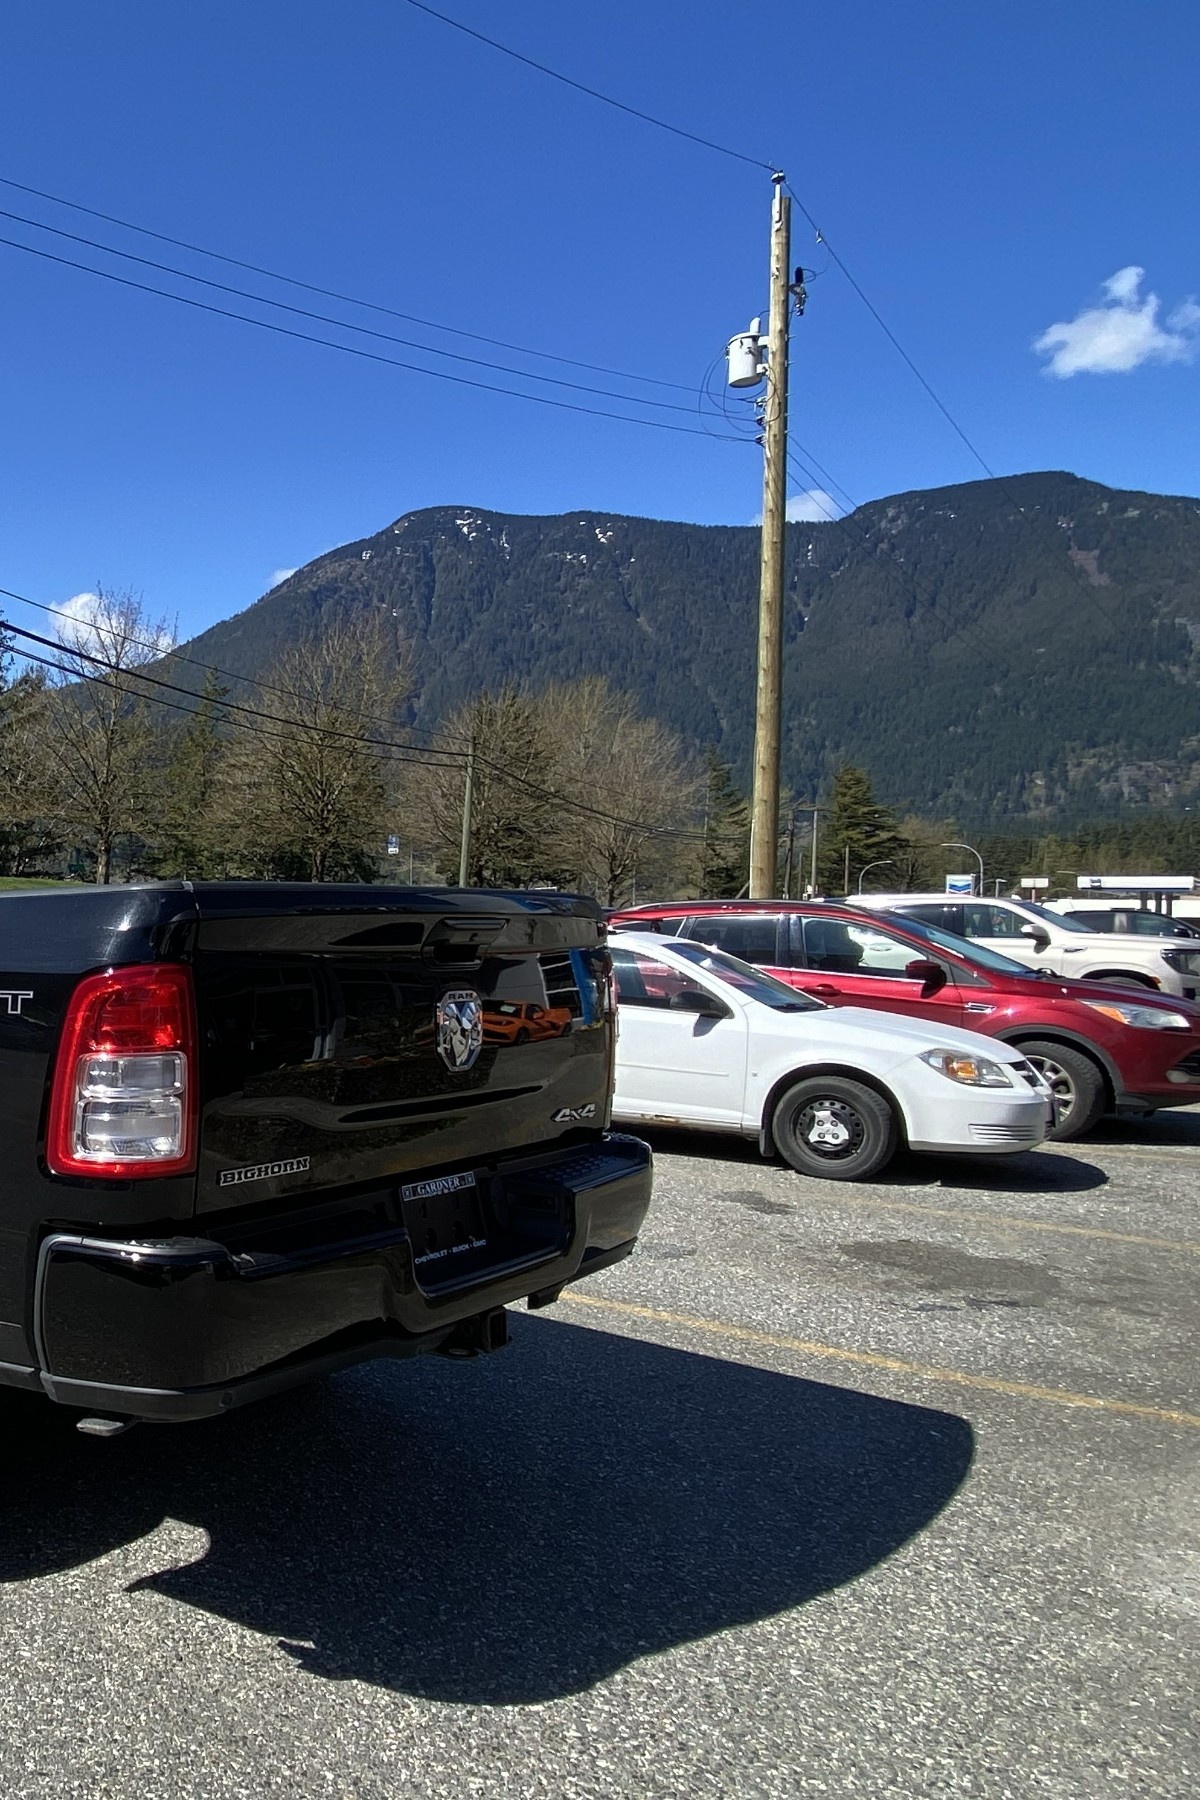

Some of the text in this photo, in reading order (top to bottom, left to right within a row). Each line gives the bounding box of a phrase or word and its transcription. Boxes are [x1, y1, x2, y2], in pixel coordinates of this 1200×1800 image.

[448, 992, 474, 1000] RAM
[220, 1156, 310, 1187] BIGHORN
[417, 1177, 460, 1195] GARDNER
